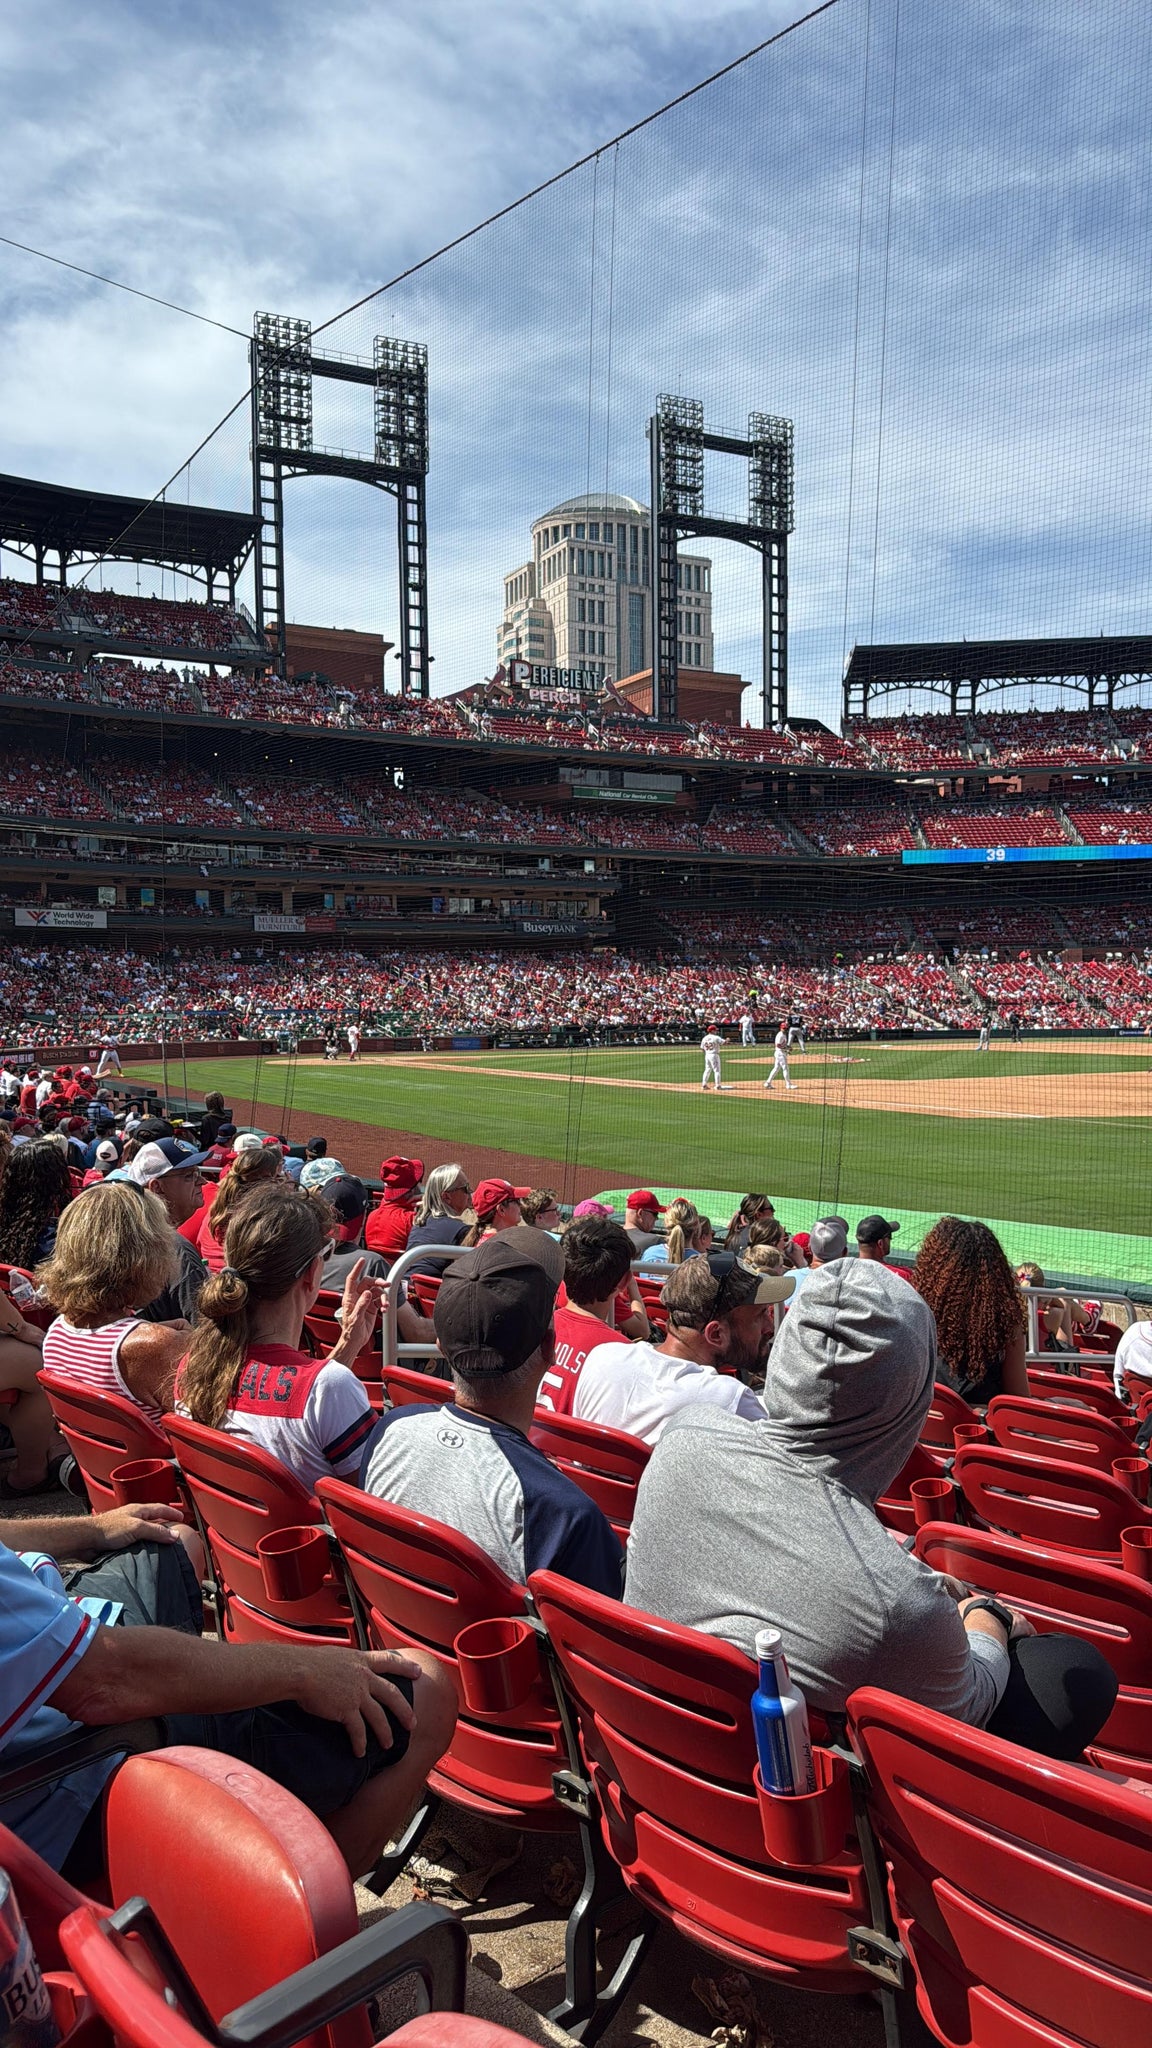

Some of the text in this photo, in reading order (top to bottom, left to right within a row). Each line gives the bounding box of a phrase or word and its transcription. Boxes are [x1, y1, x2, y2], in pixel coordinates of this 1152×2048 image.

[529, 689, 580, 704] PERCH
[599, 790, 622, 798] National
[986, 849, 1006, 861] 39
[53, 911, 74, 919] World
[53, 918, 95, 927] Technology
[257, 916, 294, 924] MUELLER
[257, 923, 304, 931] FURNITURE
